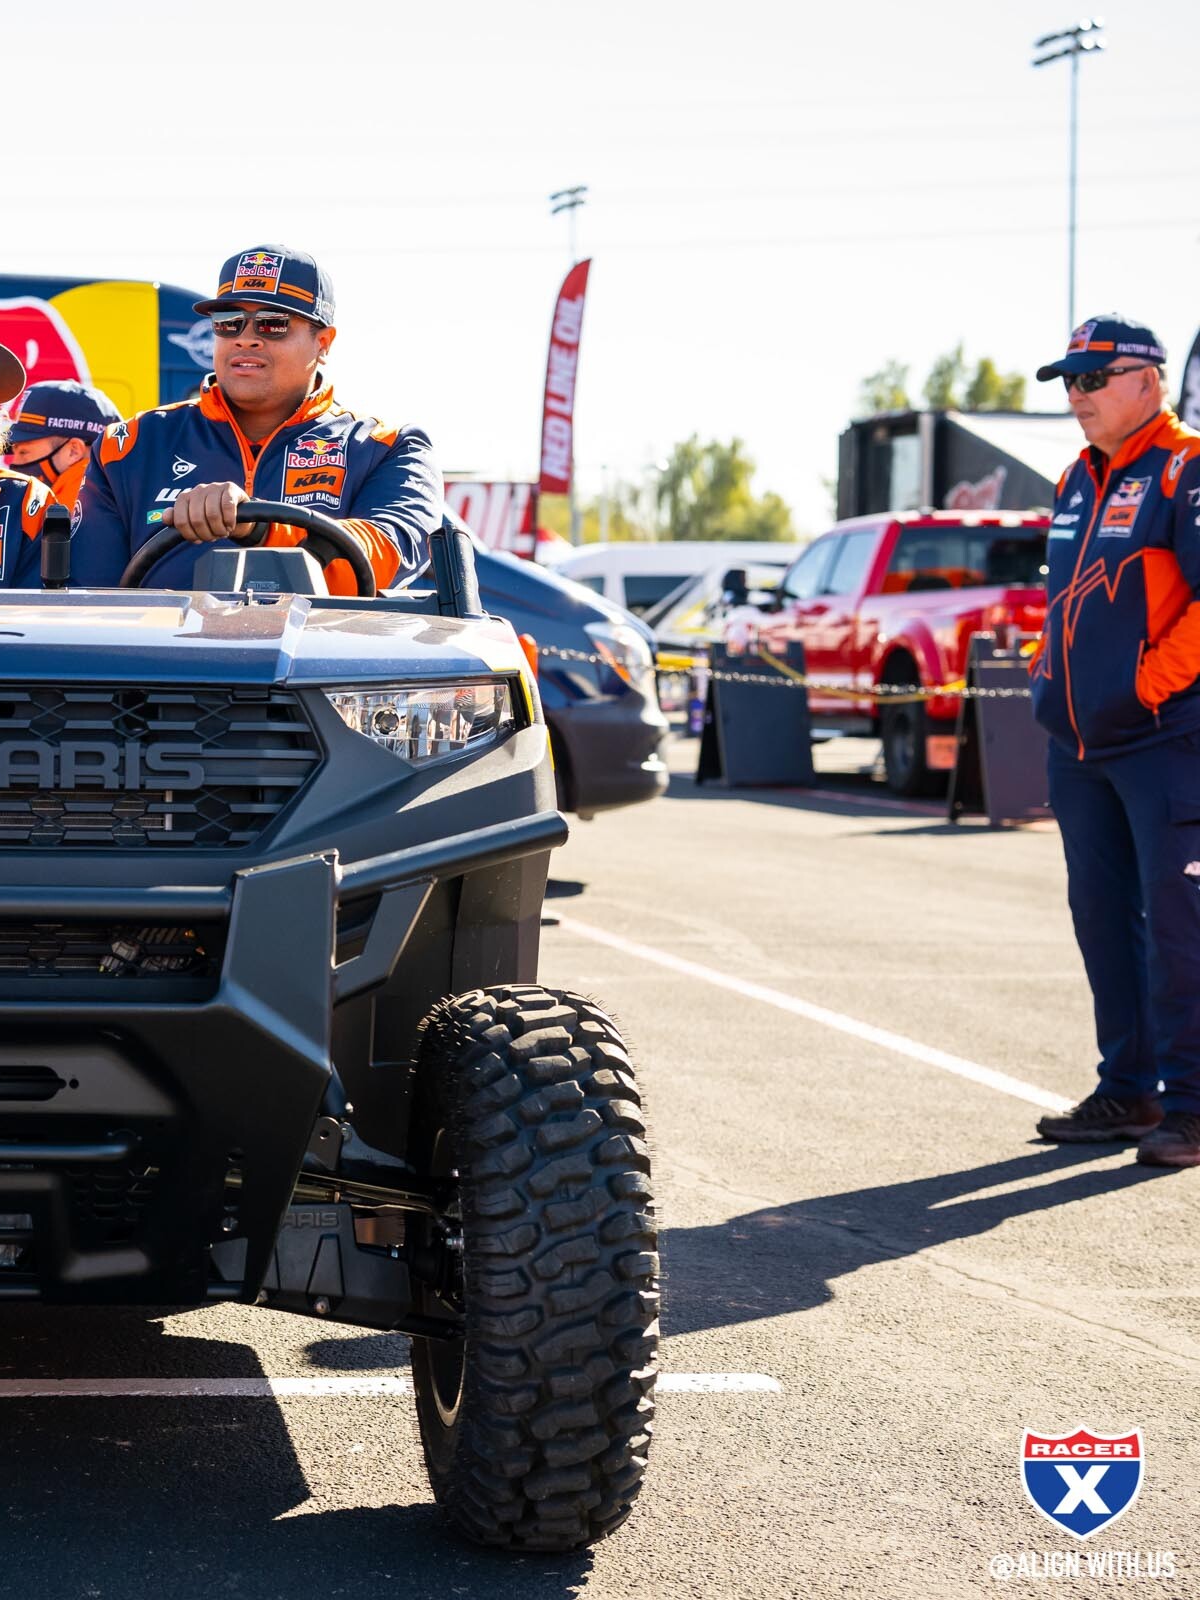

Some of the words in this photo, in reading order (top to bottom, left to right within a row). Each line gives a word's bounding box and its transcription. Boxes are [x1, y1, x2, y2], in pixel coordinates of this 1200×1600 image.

[238, 265, 256, 276] Red
[257, 266, 279, 277] Bull
[242, 279, 266, 288] KTM
[553, 294, 584, 344] OIL
[545, 345, 577, 416] LINE
[47, 417, 85, 431] FACTORY
[87, 422, 106, 434] RAC
[540, 418, 569, 481] RED
[288, 453, 317, 468] Red
[317, 452, 345, 467] Bull
[293, 471, 336, 488] KTM
[284, 493, 314, 505] FACTORY
[315, 492, 340, 506] RACING
[279, 1212, 339, 1228] ARIS
